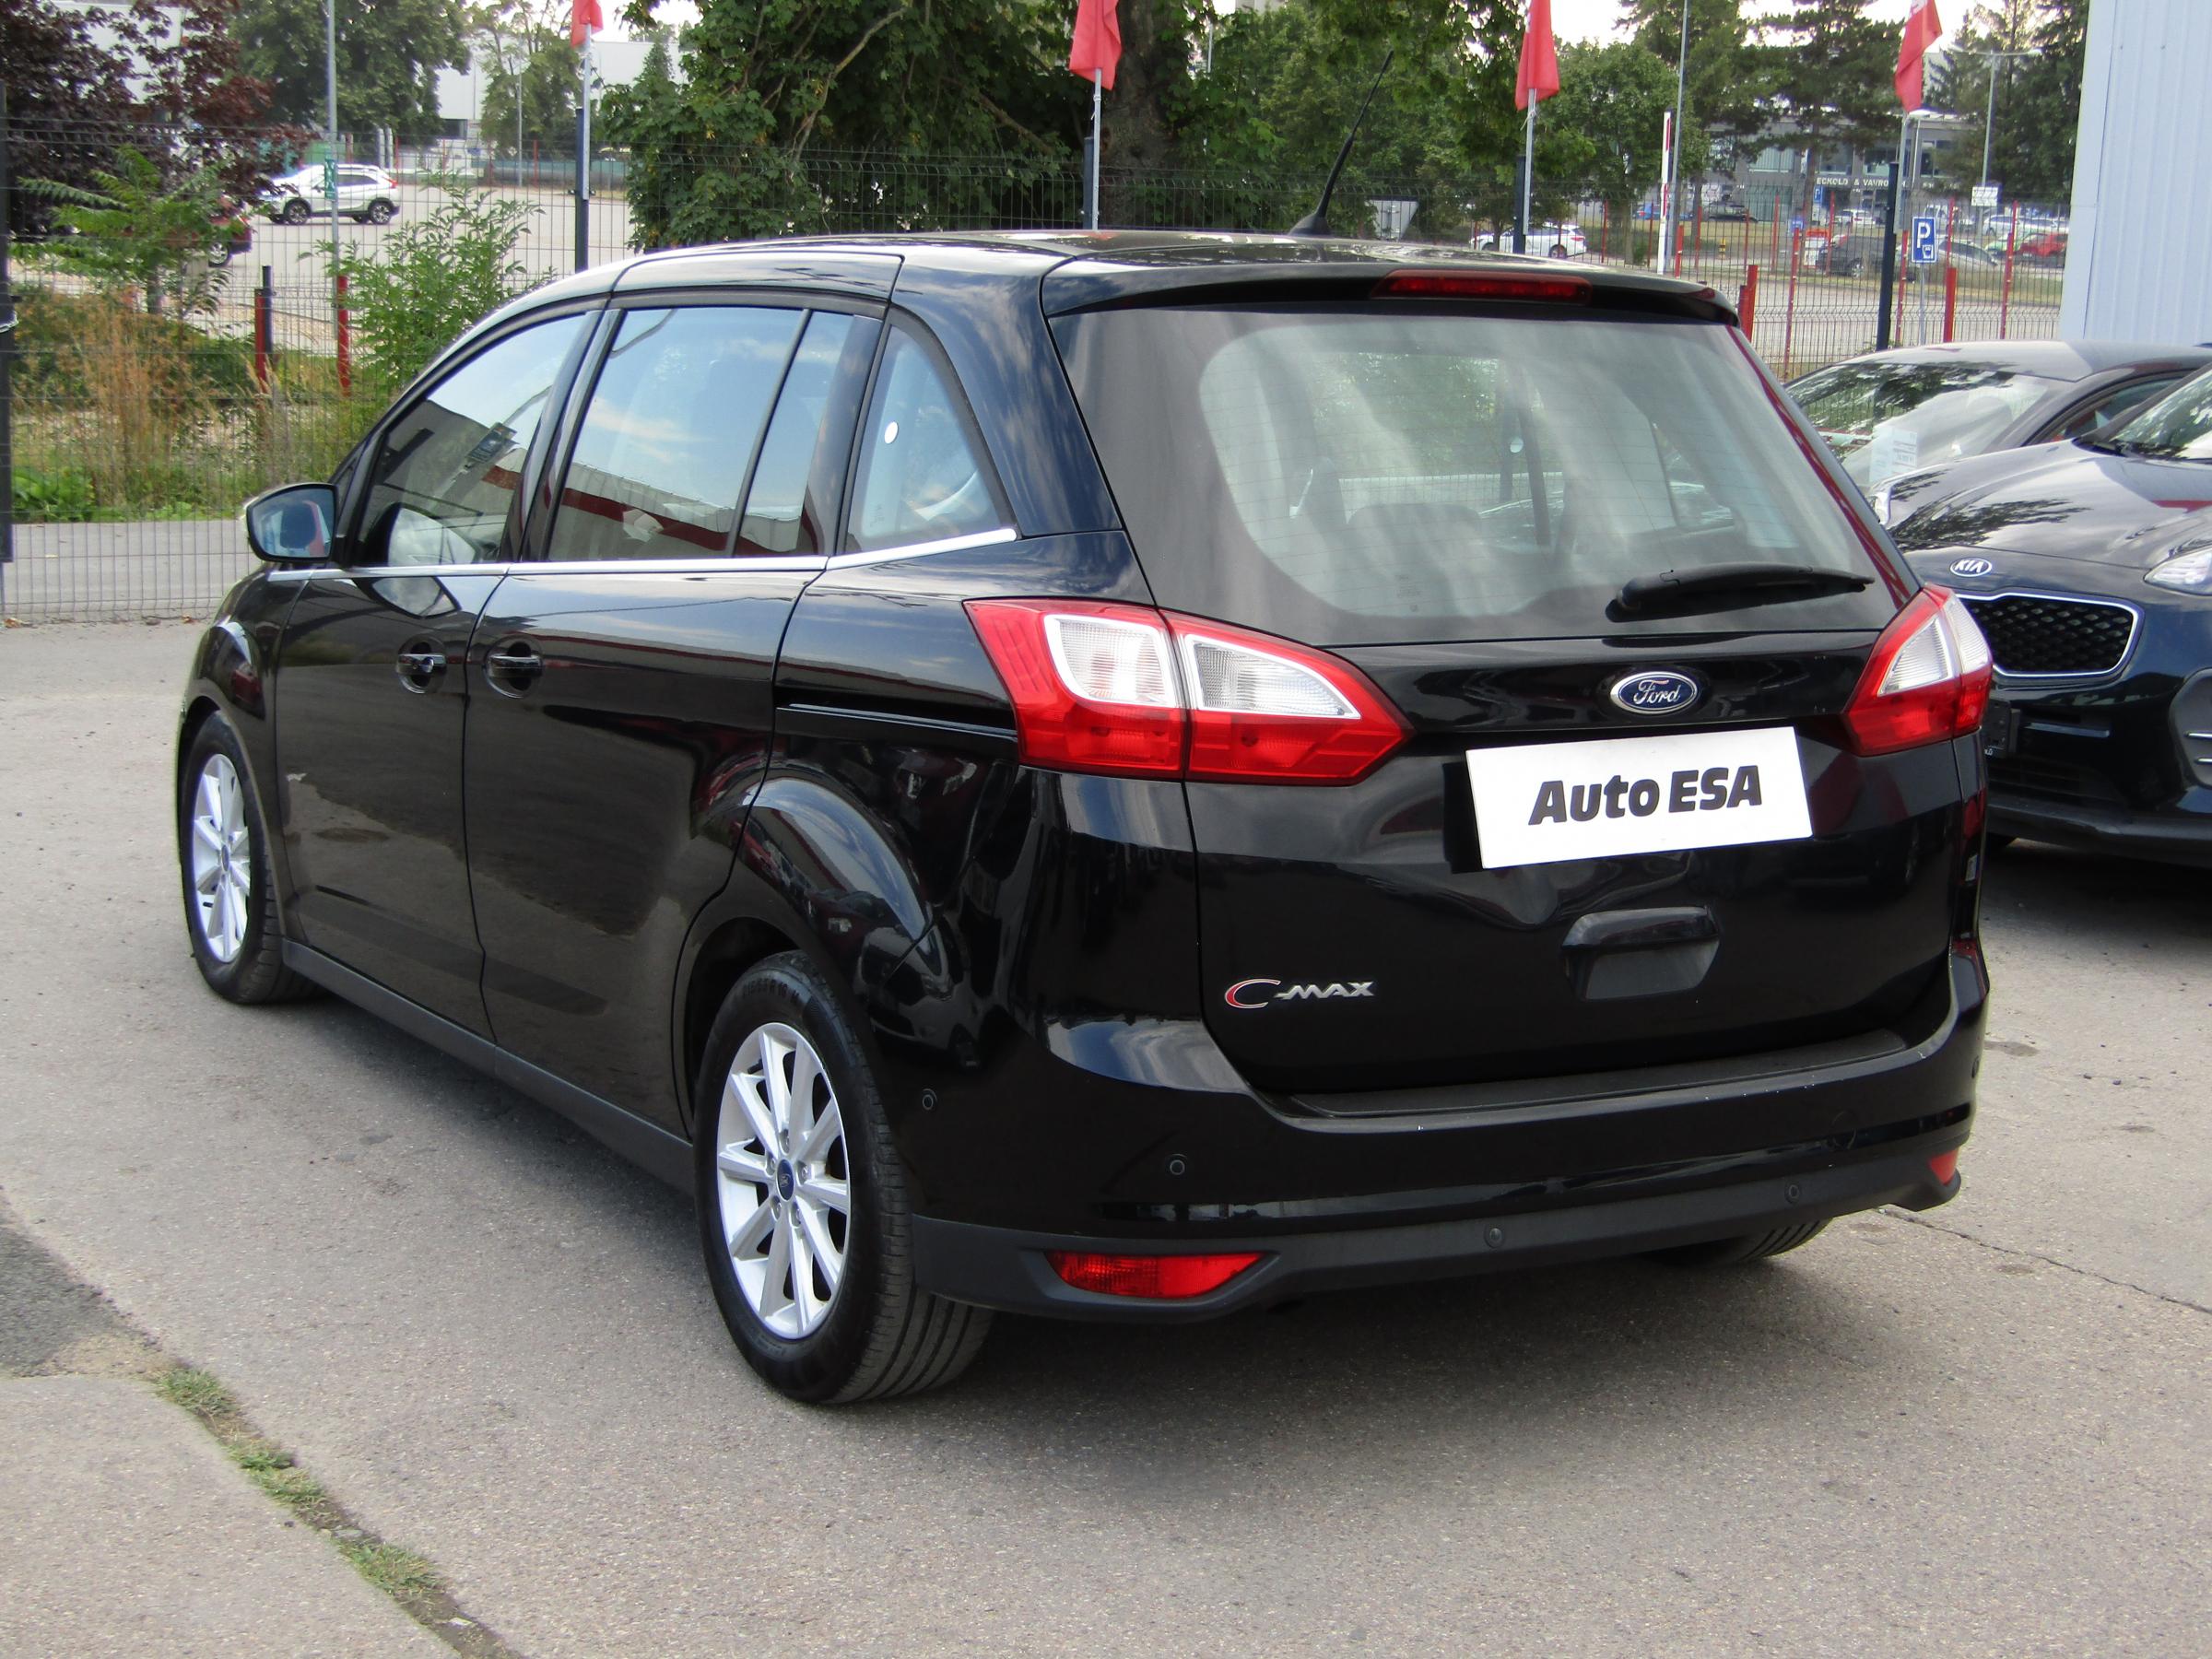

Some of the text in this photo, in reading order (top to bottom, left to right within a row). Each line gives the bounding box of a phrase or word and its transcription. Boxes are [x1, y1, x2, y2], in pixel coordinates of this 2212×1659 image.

[1816, 177, 1849, 185] ECKOLD
[1853, 178, 1860, 186] &
[1916, 222, 1931, 248] P
[1954, 559, 1984, 573] KIA
[1632, 679, 1682, 705] Ford
[1527, 764, 1762, 826] Auto ESA
